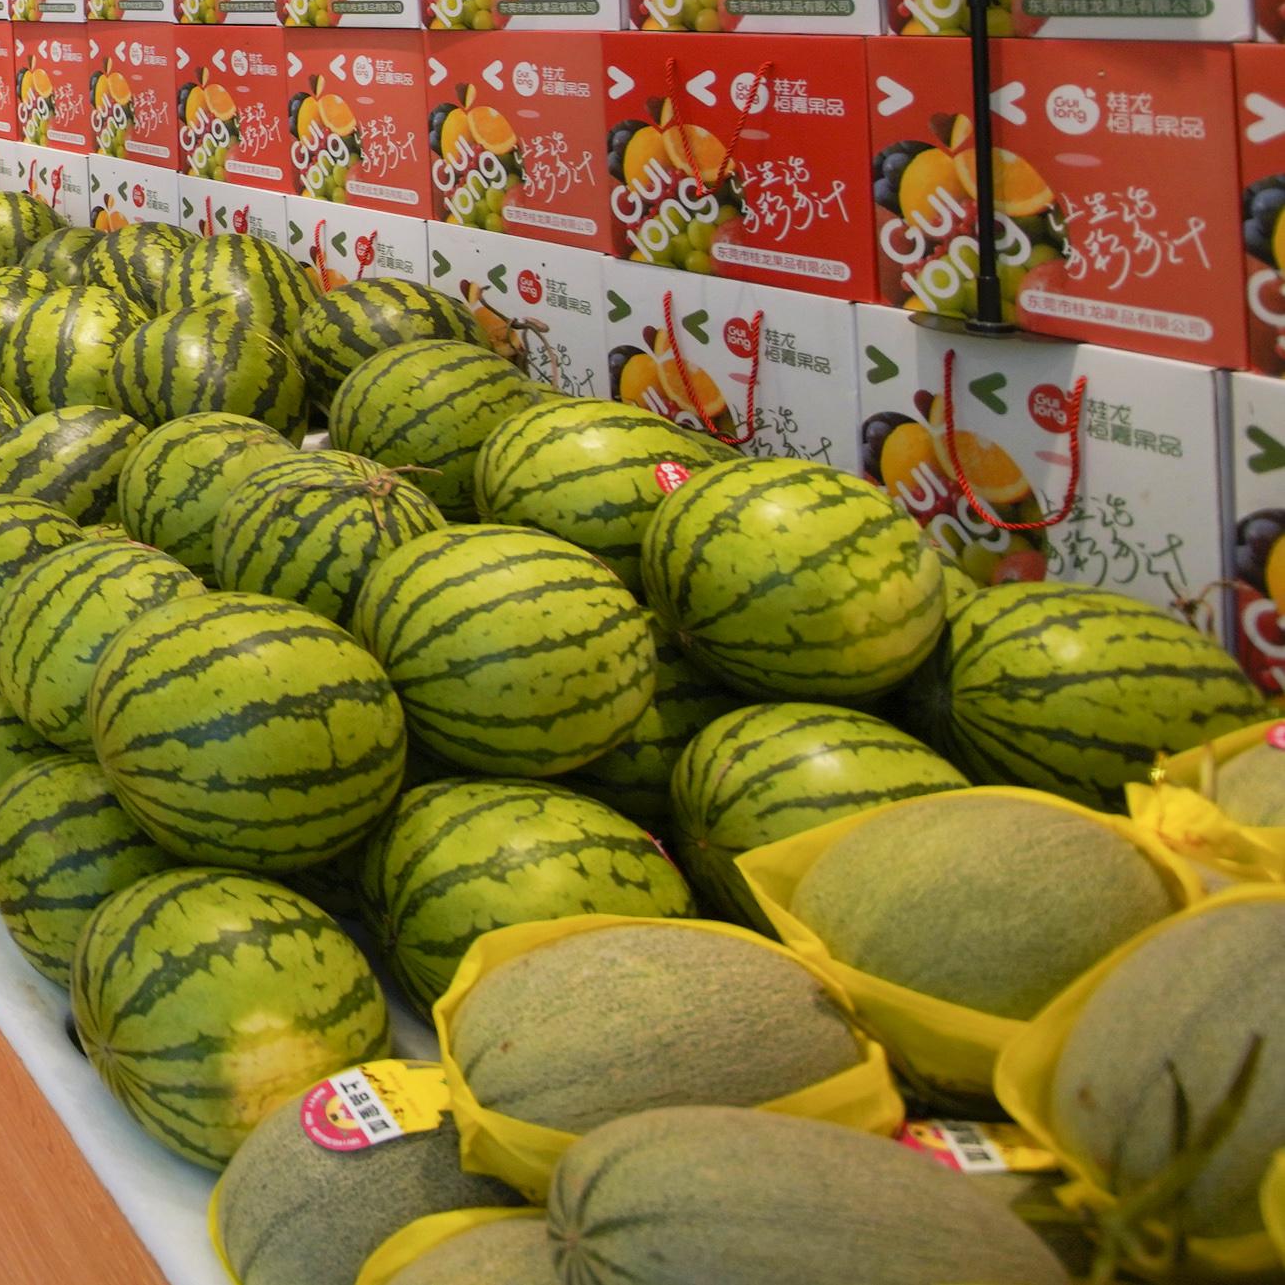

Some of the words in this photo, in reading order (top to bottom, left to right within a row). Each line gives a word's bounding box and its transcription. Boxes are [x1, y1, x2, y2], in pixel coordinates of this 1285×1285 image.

[18, 87, 33, 122] Gui
[773, 79, 807, 95] 桂龙
[1054, 96, 1080, 110] Gui
[1106, 92, 1152, 113] 桂龙
[23, 97, 49, 141] long
[91, 93, 112, 133] Gui
[96, 103, 127, 154] long
[180, 107, 210, 151] Gui
[1053, 107, 1087, 123] long
[187, 118, 230, 177] long
[290, 119, 324, 170] Gui
[300, 134, 349, 197] long
[432, 135, 475, 192] Gui
[444, 151, 507, 224] long
[611, 158, 671, 224] Gui
[730, 156, 809, 194] 让生活
[627, 177, 719, 262] long
[880, 187, 966, 264] Gui
[1048, 187, 1156, 232] 让生活
[718, 246, 845, 280] 东莞市桂龙果品有限公司
[1063, 217, 1211, 291] 多彩多汁
[1028, 294, 1206, 338] 东莞市桂龙果品有限公司
[765, 328, 795, 349] 桂龙
[1033, 405, 1067, 424] long
[1034, 393, 1060, 409] Gui
[1087, 399, 1132, 424] 桂龙
[895, 462, 948, 512] ui
